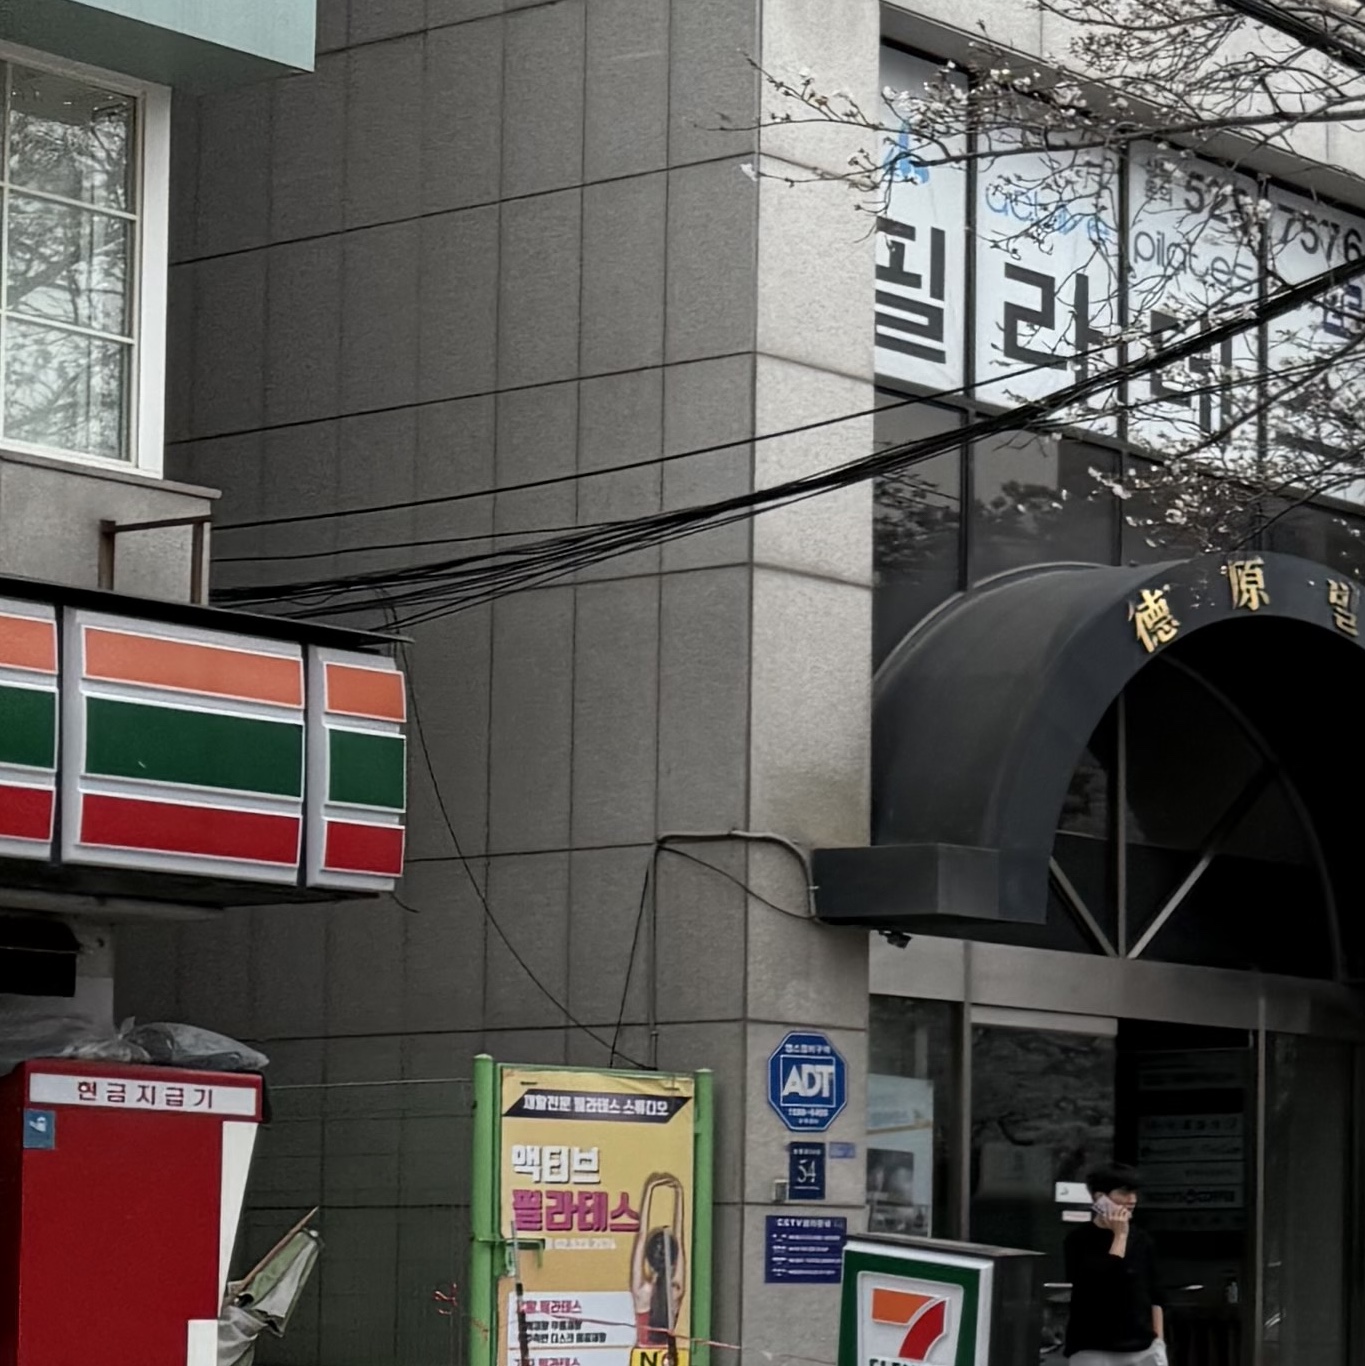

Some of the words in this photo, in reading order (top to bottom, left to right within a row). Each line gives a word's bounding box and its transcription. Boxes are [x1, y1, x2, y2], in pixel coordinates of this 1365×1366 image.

[77, 1081, 213, 1109] 현금지급기
[782, 1064, 834, 1097] ADT
[574, 1096, 621, 1114] 필라테스
[623, 1099, 670, 1116] 스튜디오
[512, 1144, 602, 1184] 액티브
[797, 1159, 816, 1183] 54
[512, 1189, 641, 1232] 필라테스
